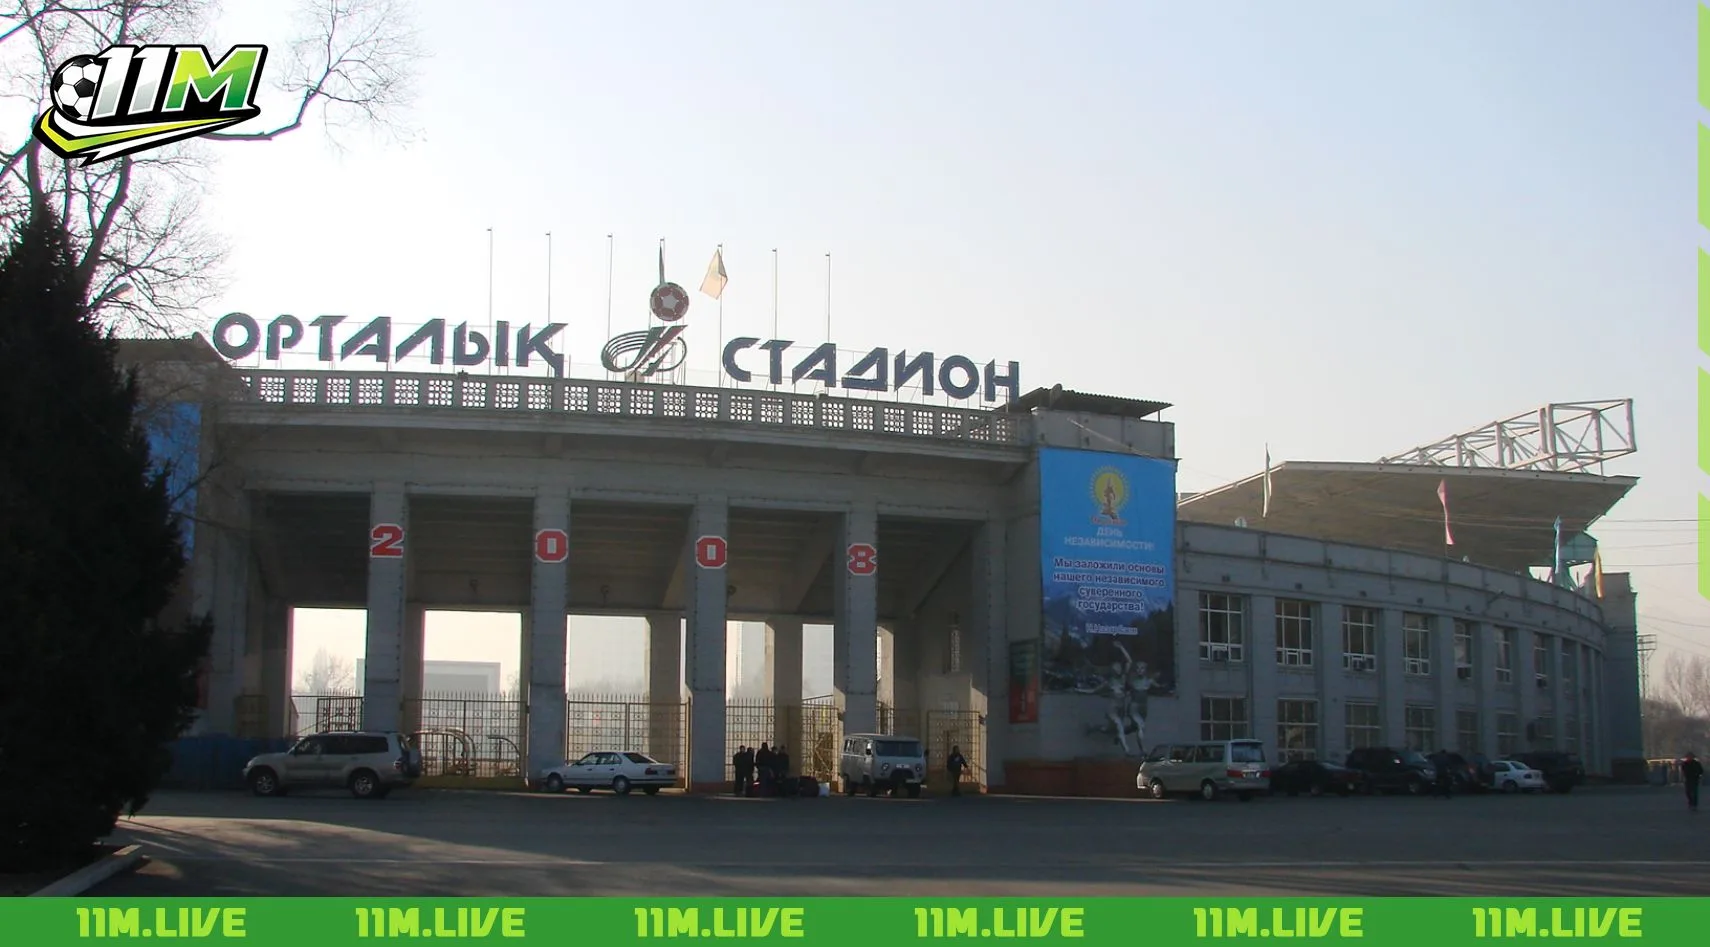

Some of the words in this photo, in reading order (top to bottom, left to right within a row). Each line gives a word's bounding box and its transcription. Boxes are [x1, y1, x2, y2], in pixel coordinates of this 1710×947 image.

[213, 312, 569, 378] ОРТАЛЫҚ
[722, 336, 1020, 402] СТАДИОН
[1096, 527, 1124, 538] ДЕНЬ
[370, 523, 405, 559] 2
[535, 528, 569, 564] 0
[696, 535, 728, 569] 0
[846, 543, 877, 576] 8
[1054, 558, 1073, 569] Мы
[1074, 560, 1126, 571] заложили
[1127, 563, 1165, 575] основы
[1053, 572, 1093, 583] нашего
[1095, 574, 1165, 588] независимого
[1079, 587, 1143, 600] суверенного
[1077, 600, 1145, 613] государства!
